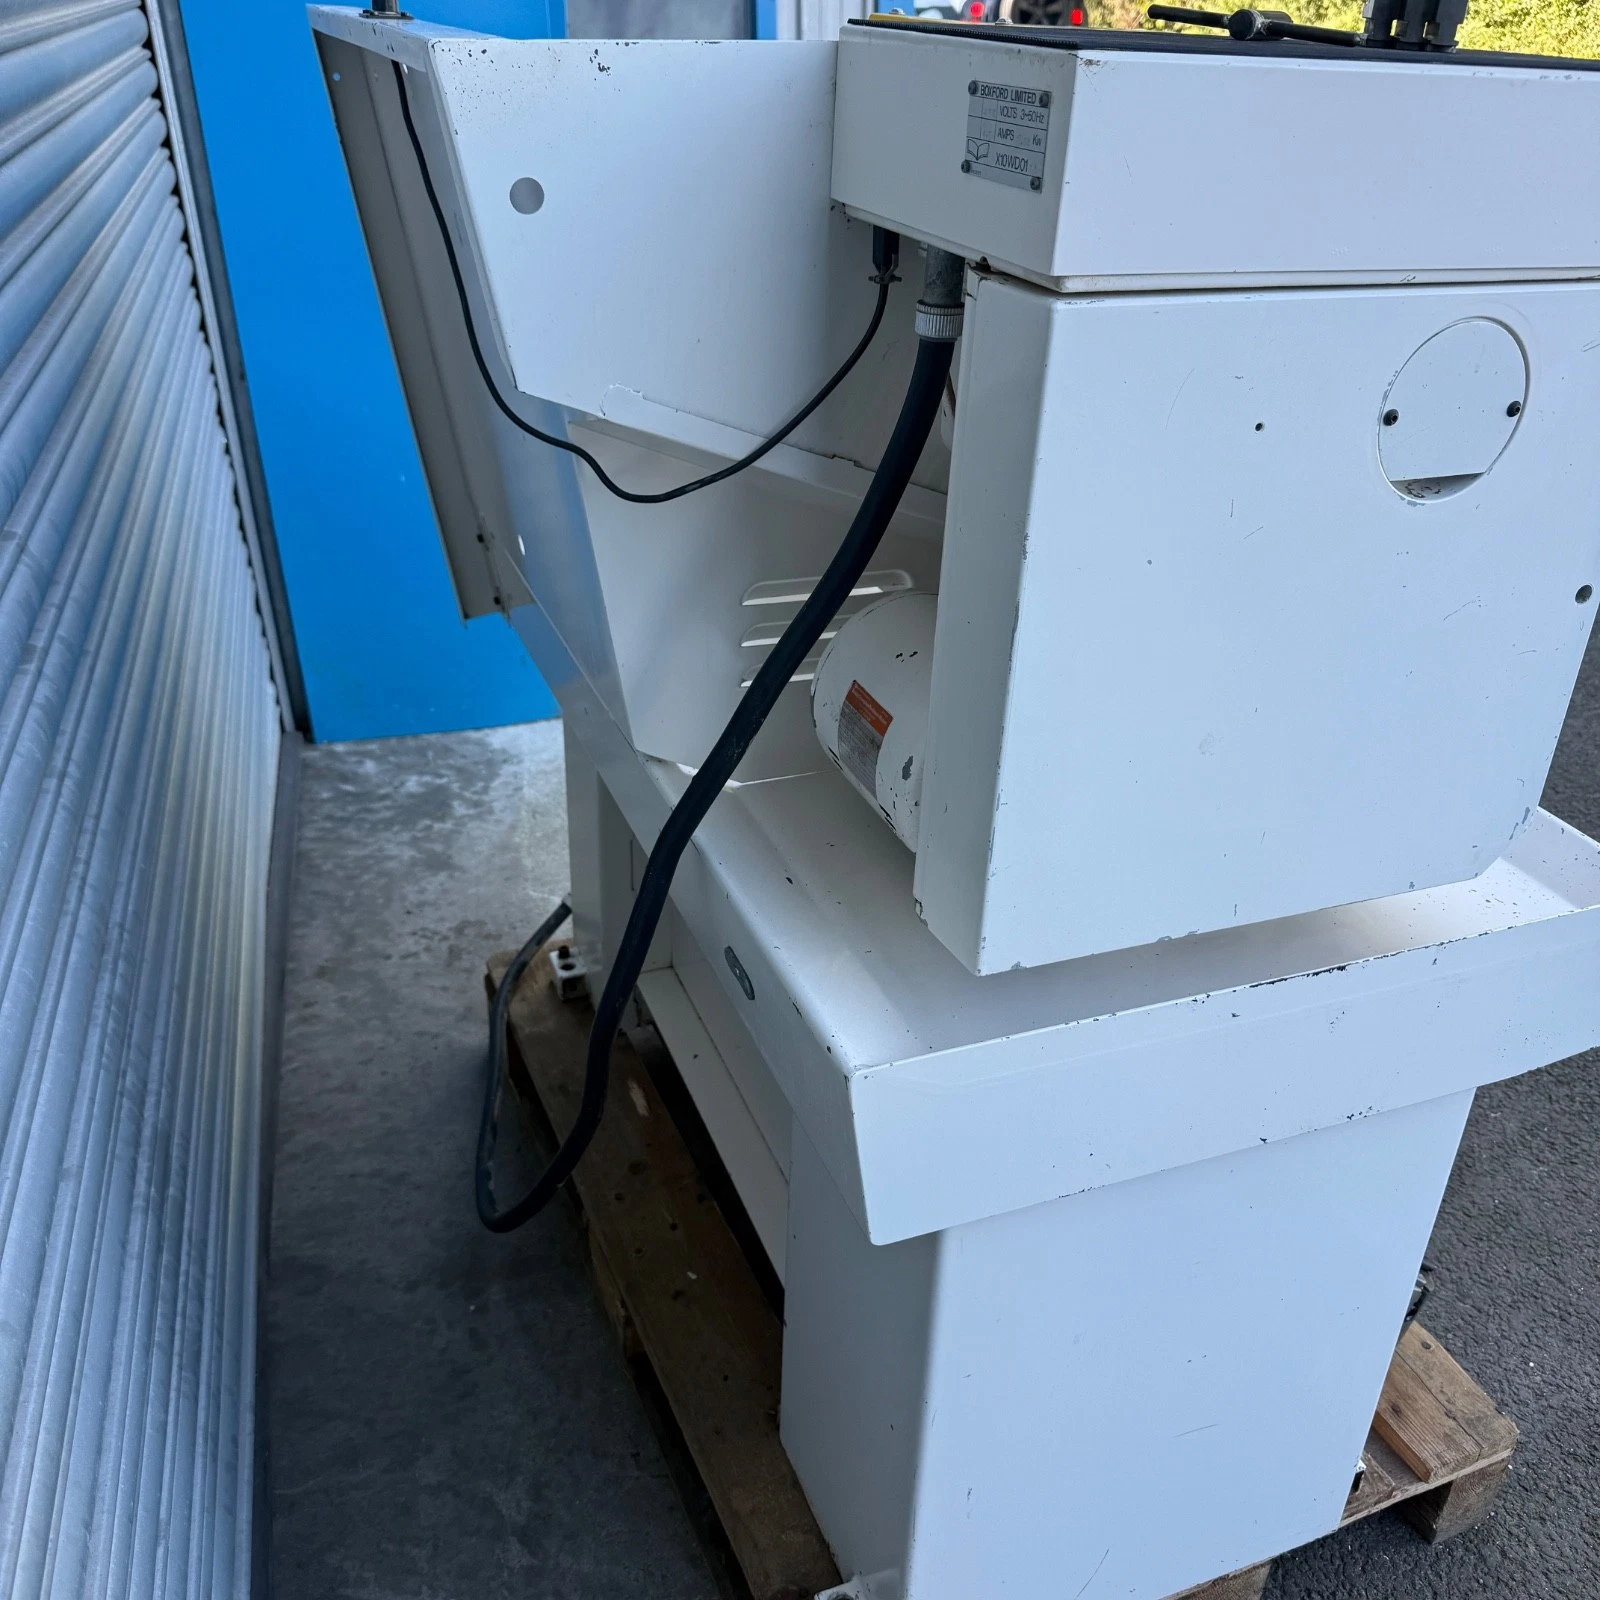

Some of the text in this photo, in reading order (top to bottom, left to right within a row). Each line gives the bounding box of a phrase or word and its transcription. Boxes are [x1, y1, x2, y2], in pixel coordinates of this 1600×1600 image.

[980, 85, 1037, 104] BOXFORD LIMITED
[999, 106, 1017, 119] VOLTS
[998, 127, 1015, 141] AMPS
